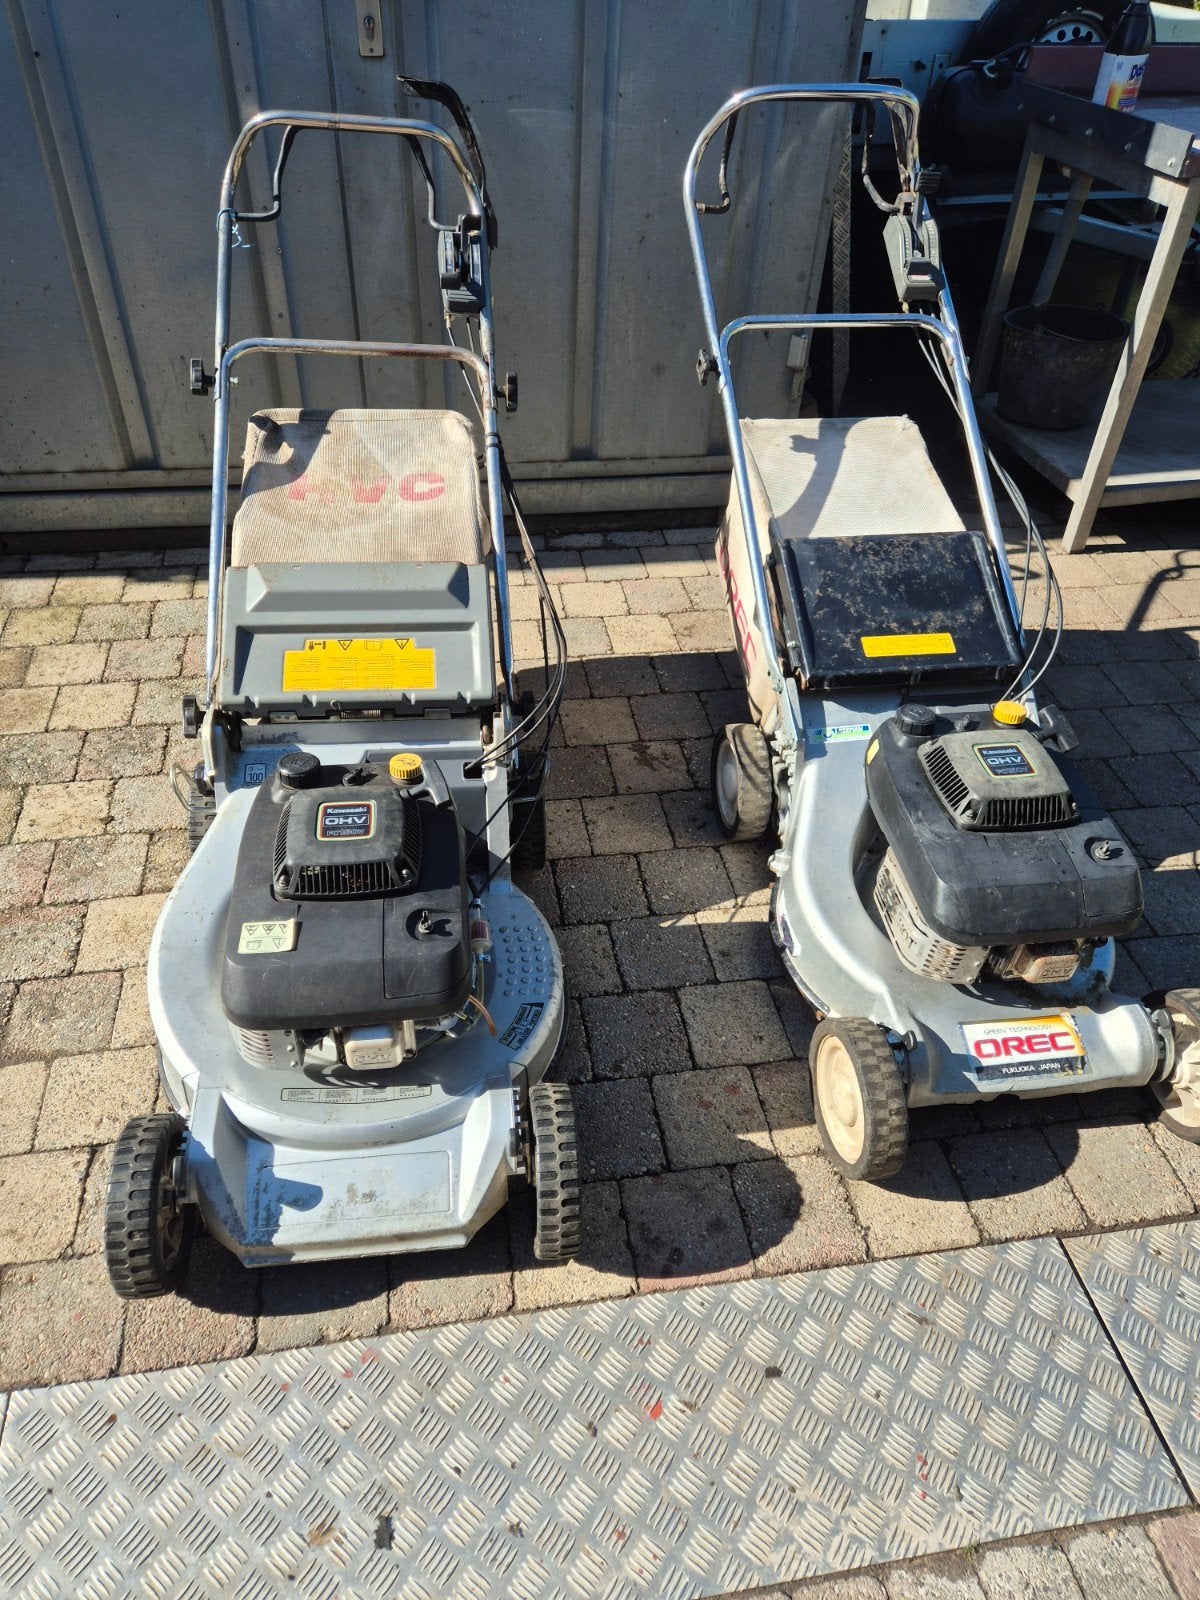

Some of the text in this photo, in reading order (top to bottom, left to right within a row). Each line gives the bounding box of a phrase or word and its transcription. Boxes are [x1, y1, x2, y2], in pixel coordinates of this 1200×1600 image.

[987, 756, 1022, 765] OHV
[249, 772, 263, 782] 100
[326, 806, 367, 814] Kawasaki
[325, 816, 367, 825] OHV
[983, 1024, 1052, 1035] GREEN TECHNOLOGY
[973, 1031, 1075, 1059] OREC
[1002, 1062, 1061, 1075] FUKUOKA JAPAN
